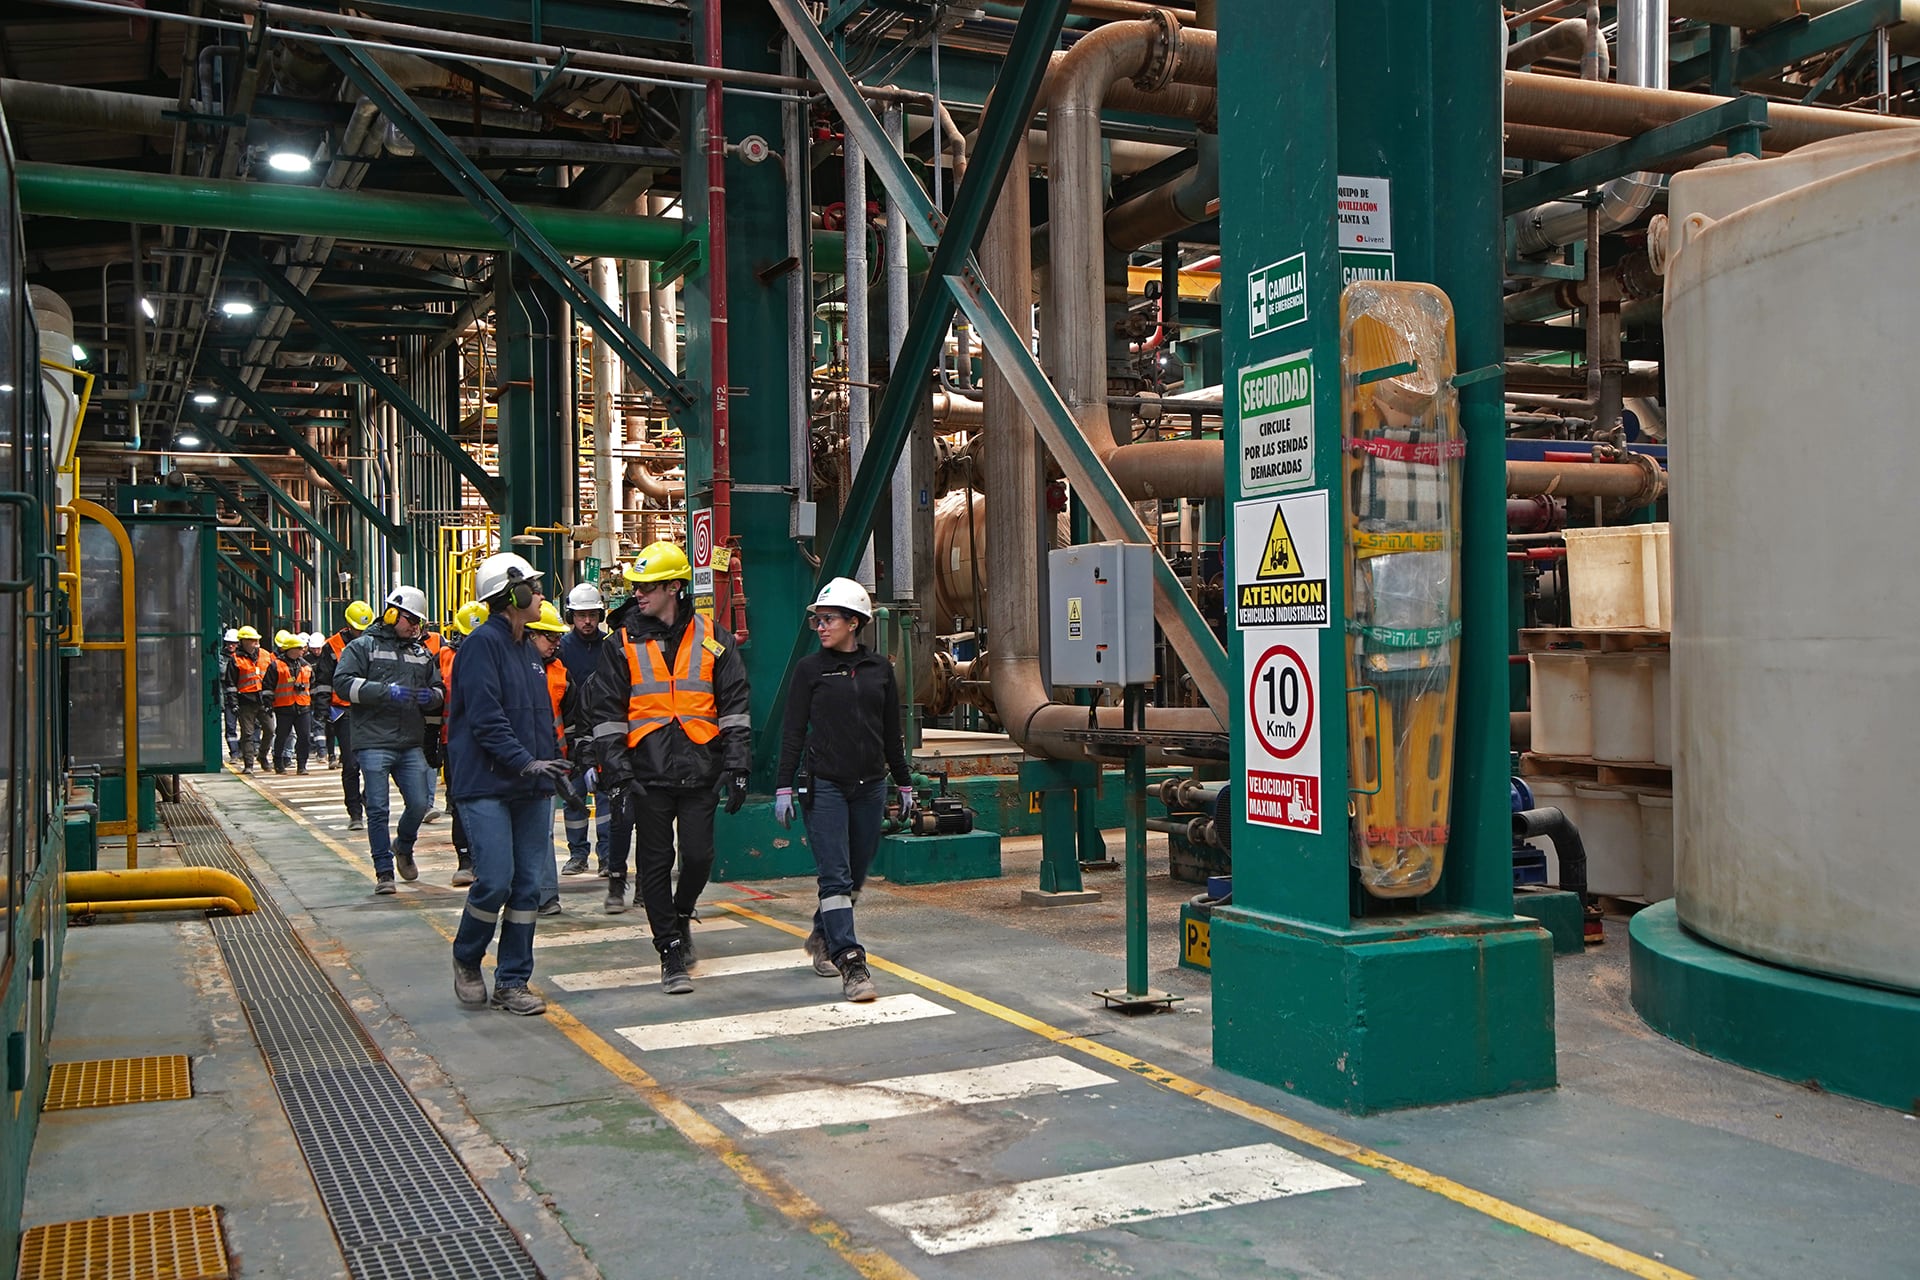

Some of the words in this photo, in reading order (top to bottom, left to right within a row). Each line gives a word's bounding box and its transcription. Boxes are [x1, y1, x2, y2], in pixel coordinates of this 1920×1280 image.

[1360, 189, 1369, 198] DE
[1361, 215, 1370, 225] SA
[1268, 271, 1303, 301] CAMILLA
[1268, 303, 1275, 316] DE
[1243, 367, 1308, 412] SEGURIDAD
[1259, 418, 1291, 437] CIRCULE
[1244, 445, 1261, 460] POR
[1262, 442, 1275, 458] LAS
[1276, 435, 1308, 455] SENDAS
[1250, 458, 1302, 480] DEMARCADAS
[1242, 582, 1322, 606] ATENCION
[1240, 606, 1275, 624] VEHICULOS
[1275, 605, 1326, 623] INDUSTRIALES
[1262, 666, 1299, 717] 10
[1266, 720, 1296, 739] Km/h
[1249, 776, 1292, 797] VELOCIDAD
[1249, 798, 1282, 819] MAXIMA
[1187, 923, 1210, 957] P-
